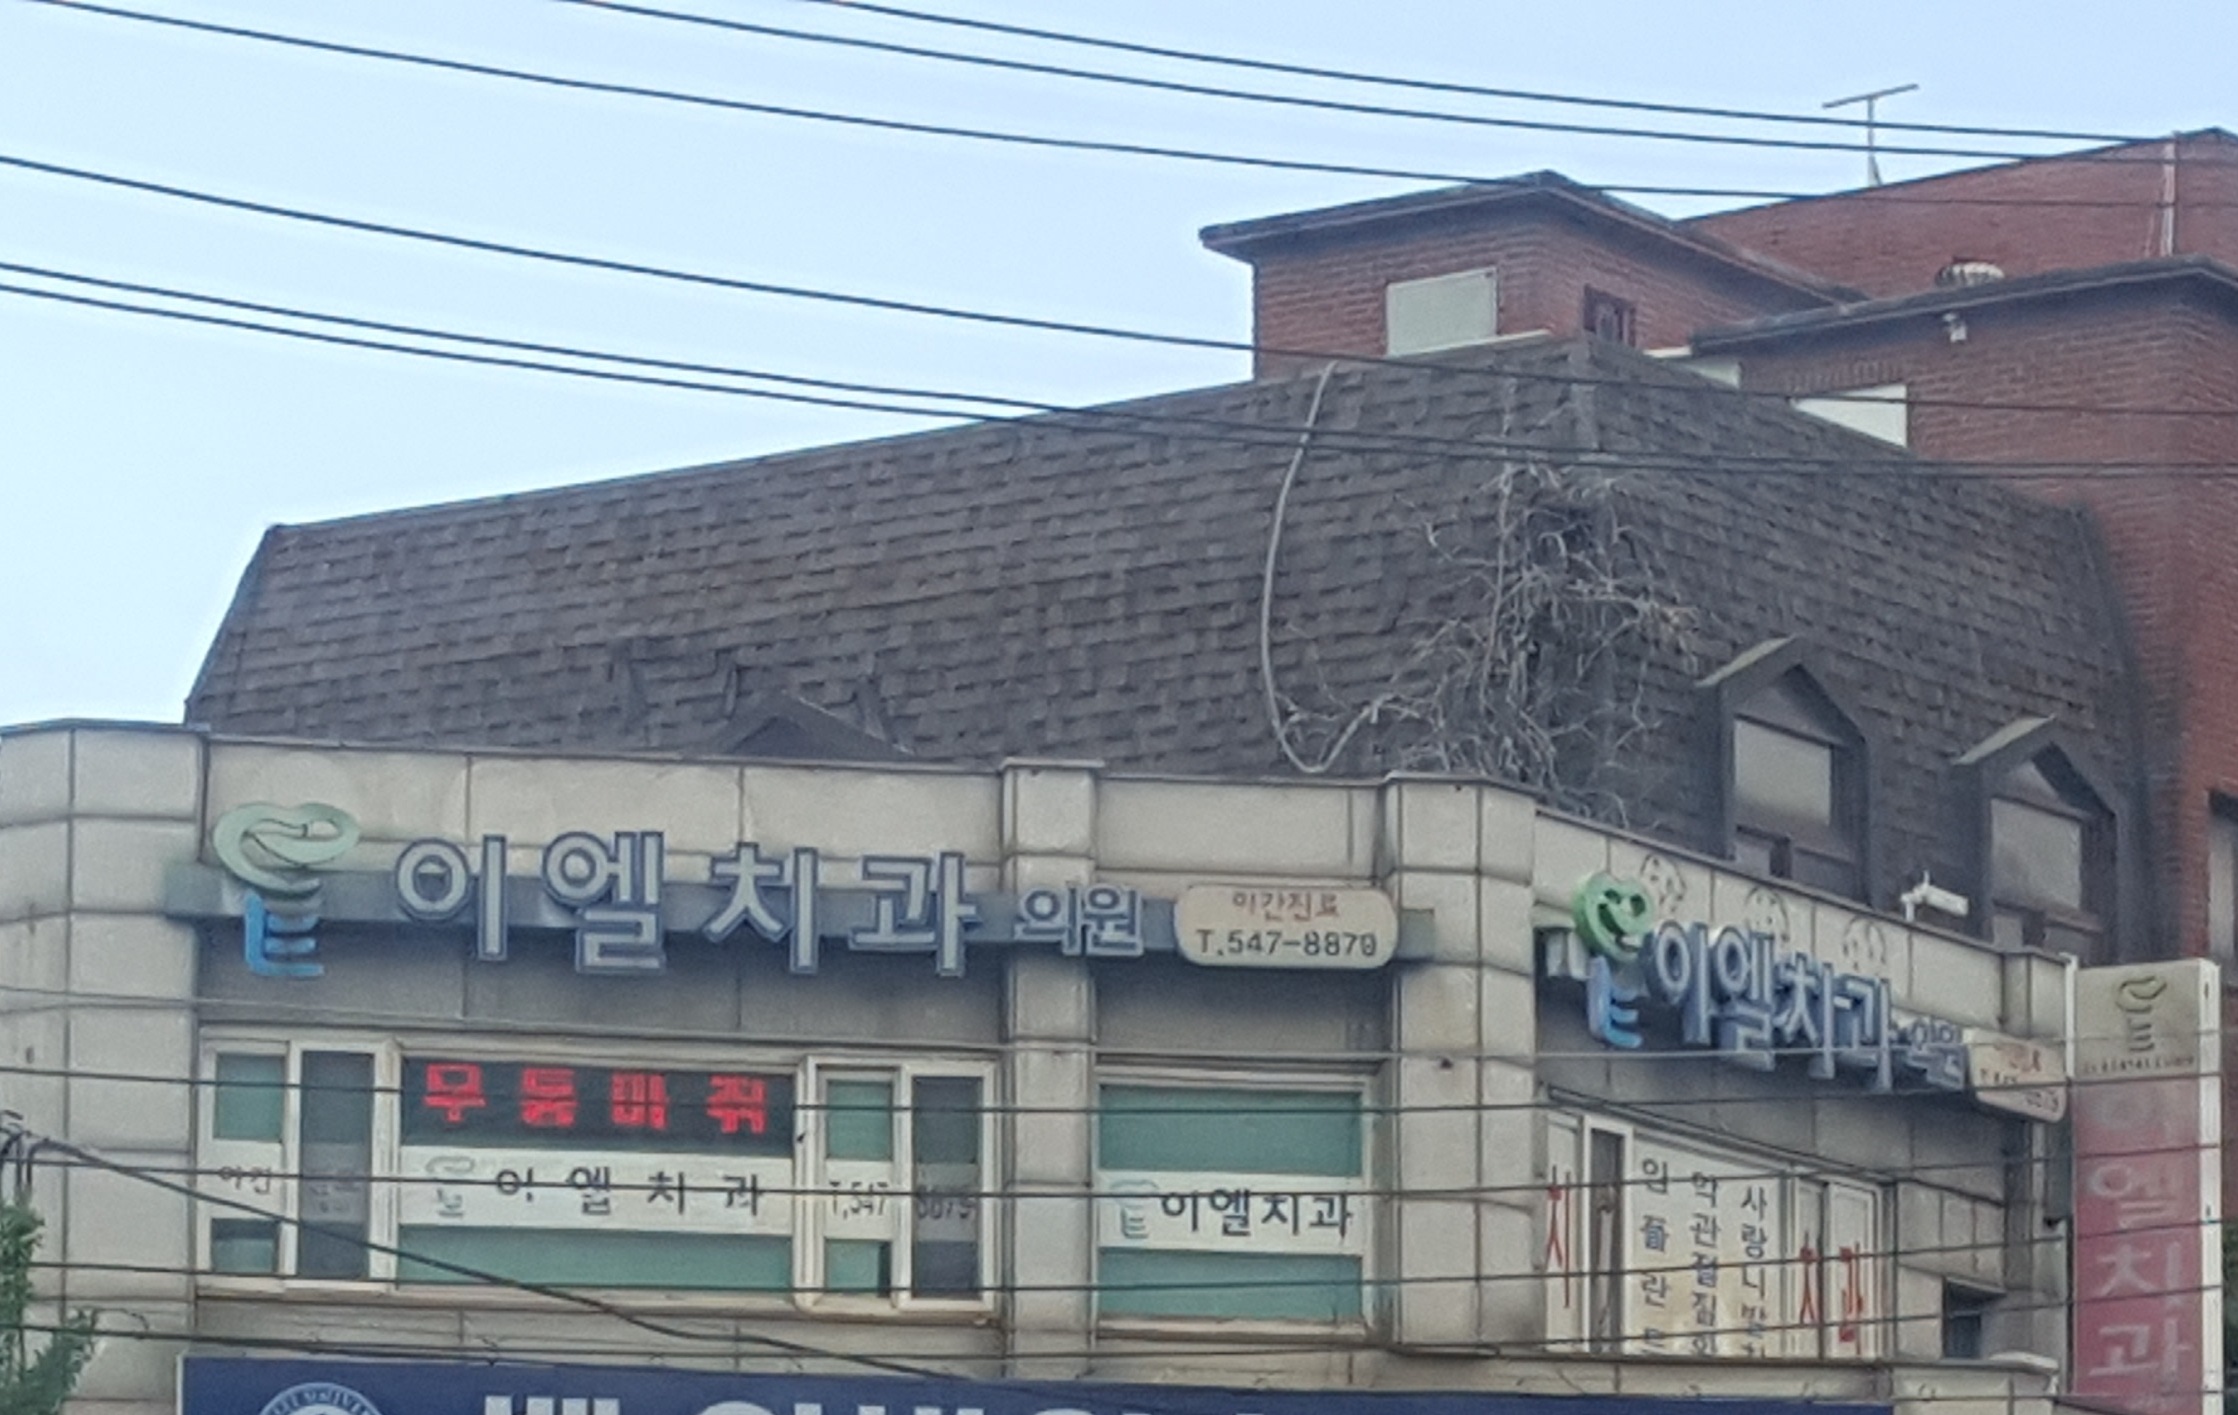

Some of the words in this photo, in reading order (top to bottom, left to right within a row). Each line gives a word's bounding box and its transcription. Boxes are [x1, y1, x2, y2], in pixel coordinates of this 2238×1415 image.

[395, 828, 983, 978] 이엘치과
[1014, 884, 1145, 958] 의원
[1640, 918, 1896, 1093] 이엘치과
[496, 1165, 764, 1217] 이엘치과
[1160, 1188, 1355, 1242] 이엘치과
